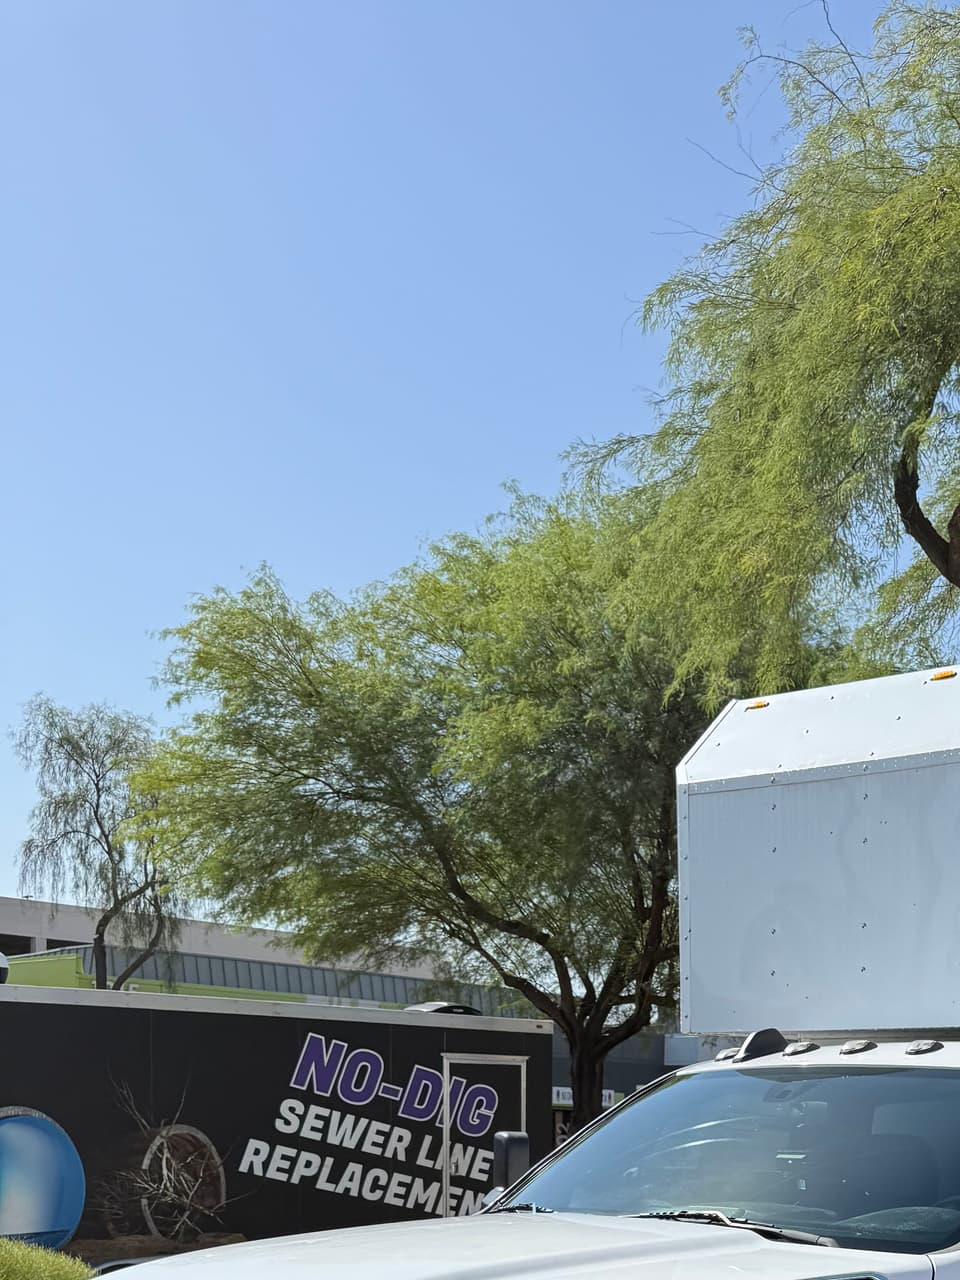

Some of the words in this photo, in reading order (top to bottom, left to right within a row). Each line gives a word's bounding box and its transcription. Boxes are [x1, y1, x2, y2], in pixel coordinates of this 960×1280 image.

[290, 1032, 499, 1137] NO-DIG
[275, 1099, 412, 1162] SEWER
[238, 1138, 486, 1217] REPLACEMEN
